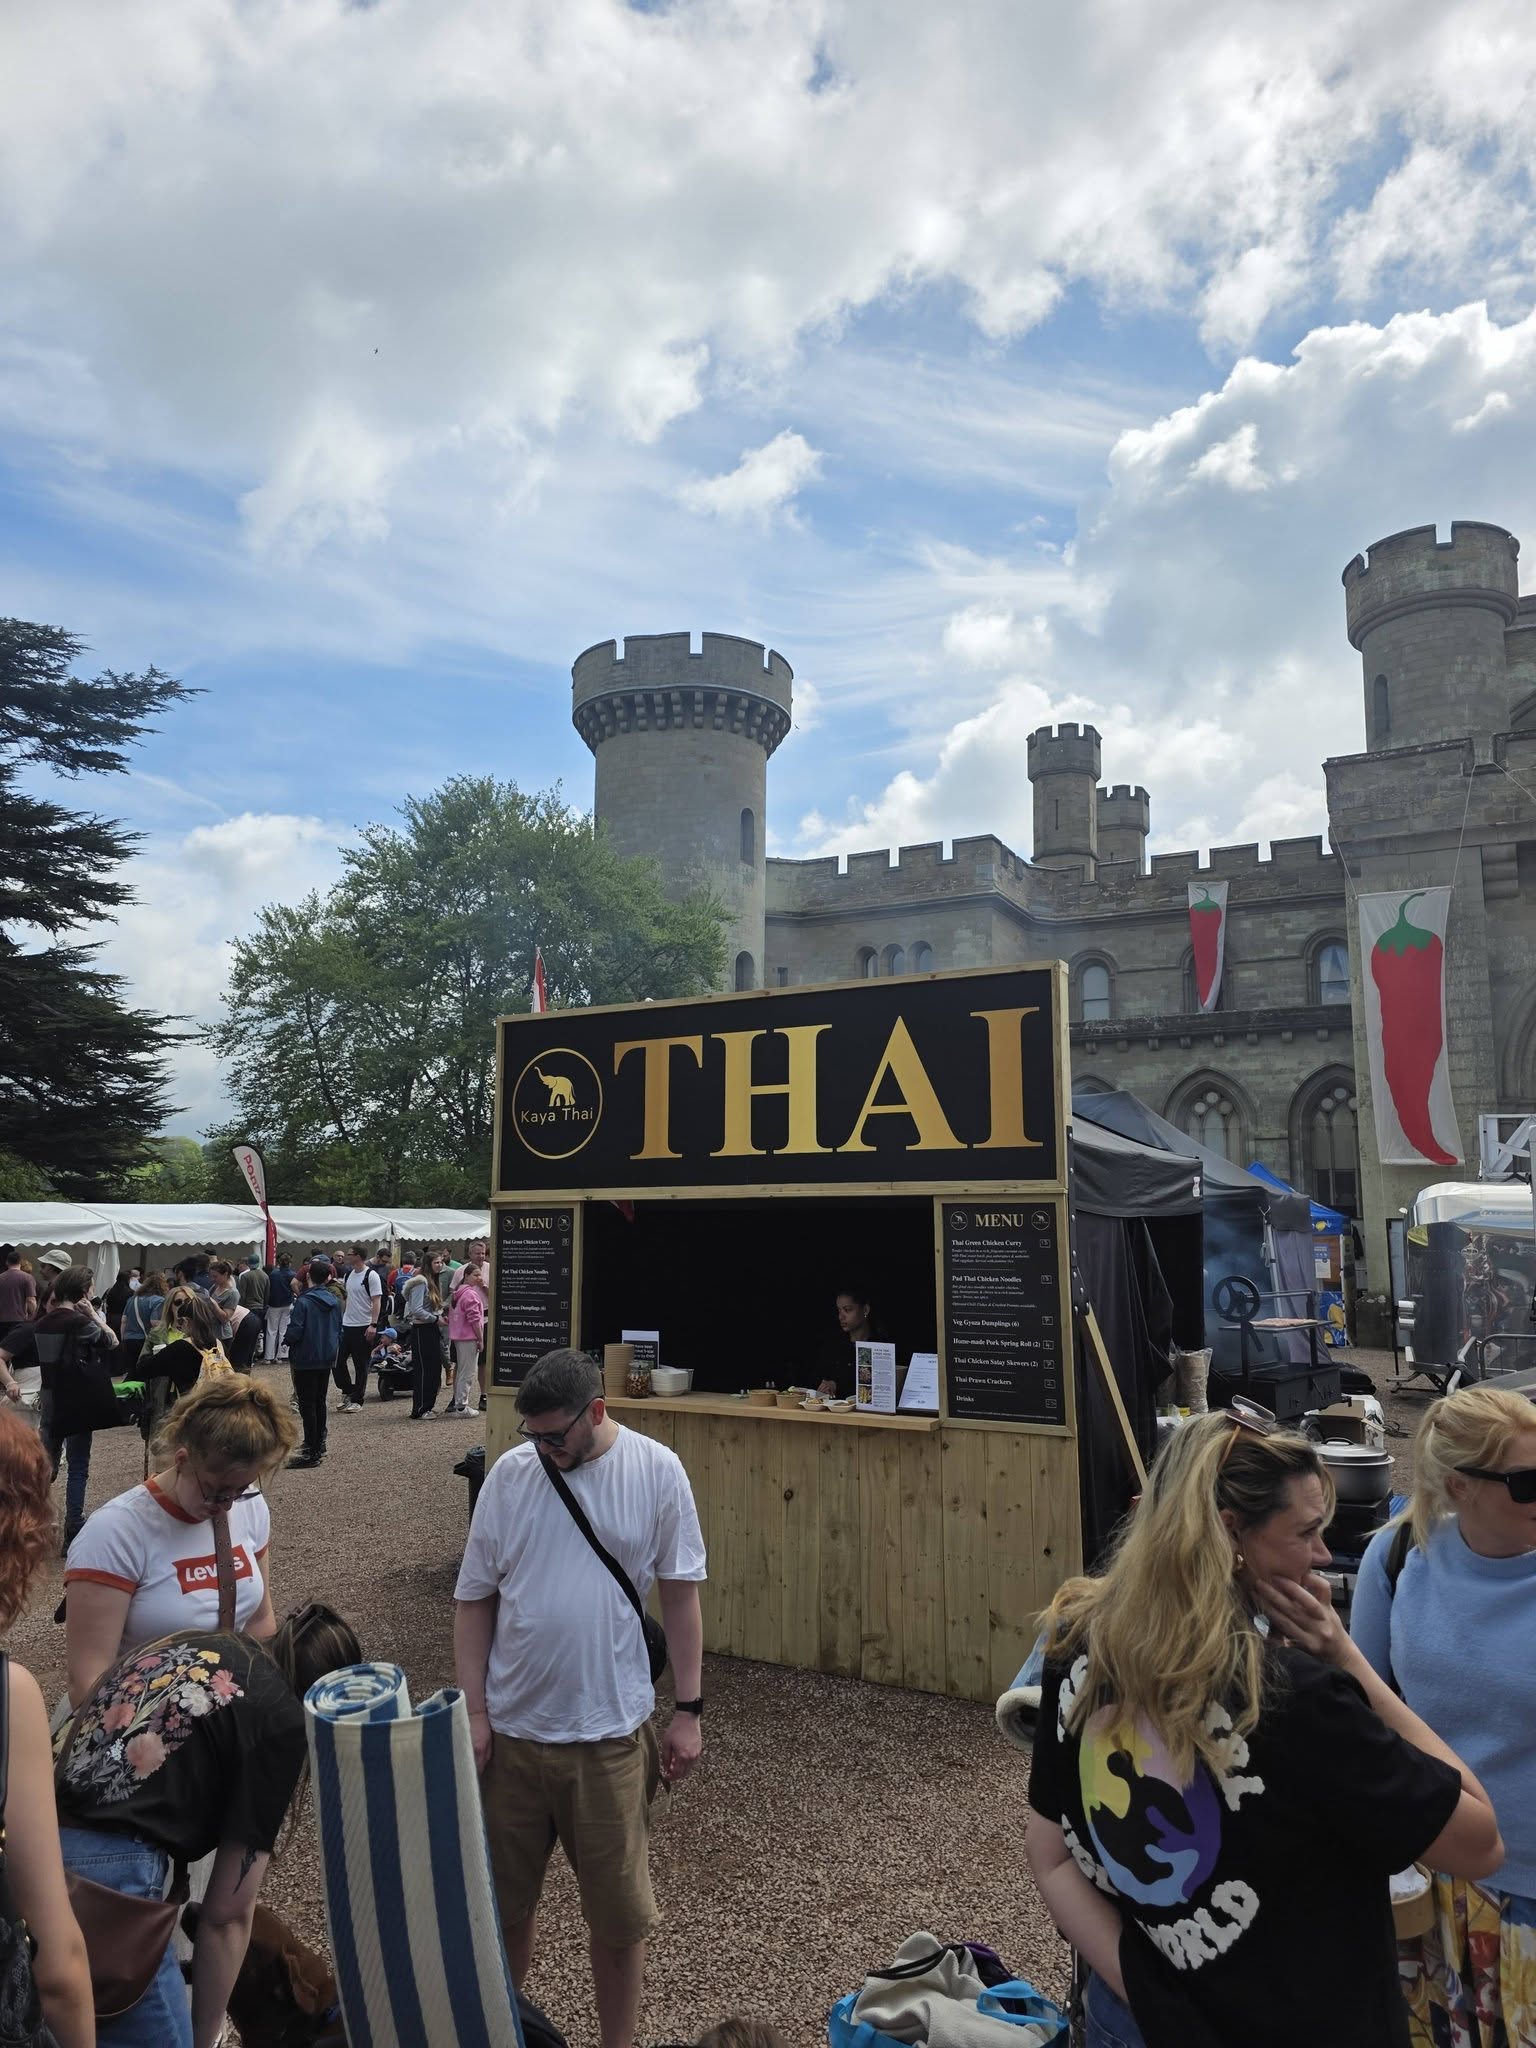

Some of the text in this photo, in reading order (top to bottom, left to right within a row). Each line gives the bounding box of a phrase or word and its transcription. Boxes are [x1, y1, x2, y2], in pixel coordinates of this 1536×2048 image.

[613, 1006, 1044, 1160] THAI
[521, 1107, 594, 1125] Kaya Thai
[520, 1218, 553, 1229] MENU
[975, 1213, 1024, 1228] MENU
[981, 1320, 1011, 1328] Dumplings
[1000, 1340, 1019, 1348] Spring
[185, 1556, 245, 1583] Levs
